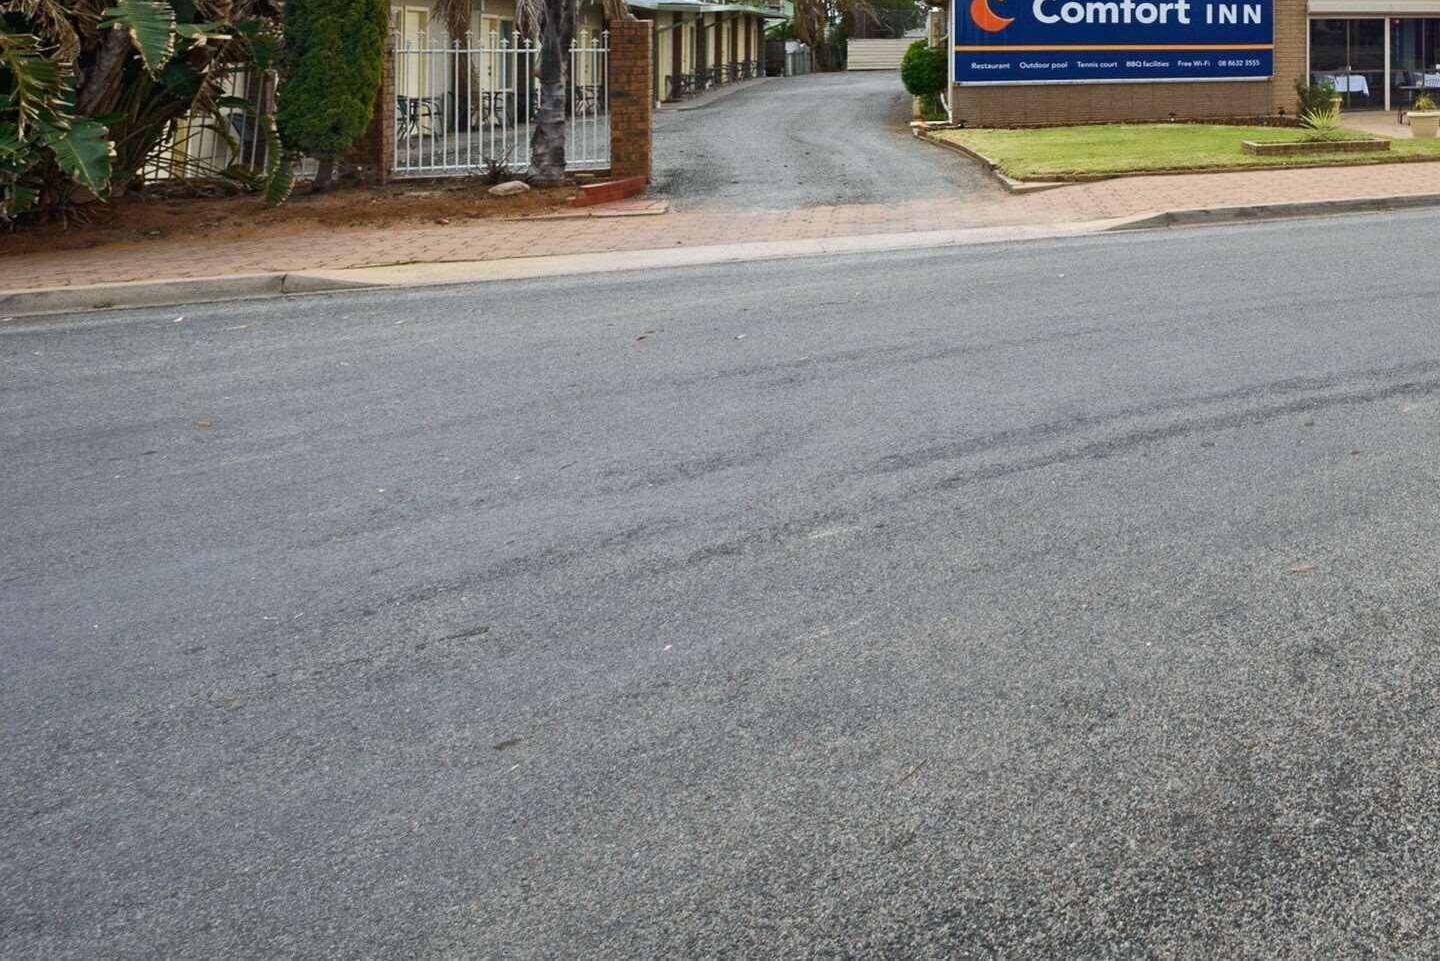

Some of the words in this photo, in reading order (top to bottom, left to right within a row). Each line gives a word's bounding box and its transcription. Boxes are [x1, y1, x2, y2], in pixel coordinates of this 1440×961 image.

[1205, 3, 1262, 25] INN
[970, 61, 1011, 71] Restaurant
[1018, 61, 1051, 70] Outdoor
[1051, 61, 1069, 71] pool
[1076, 60, 1099, 69] Tennis
[1099, 61, 1118, 69] court
[1125, 60, 1142, 68] BBQ
[1142, 60, 1170, 68] facilities
[1177, 60, 1192, 68] Free
[1192, 59, 1211, 67] Wi-Fi
[1217, 59, 1227, 67] 08
